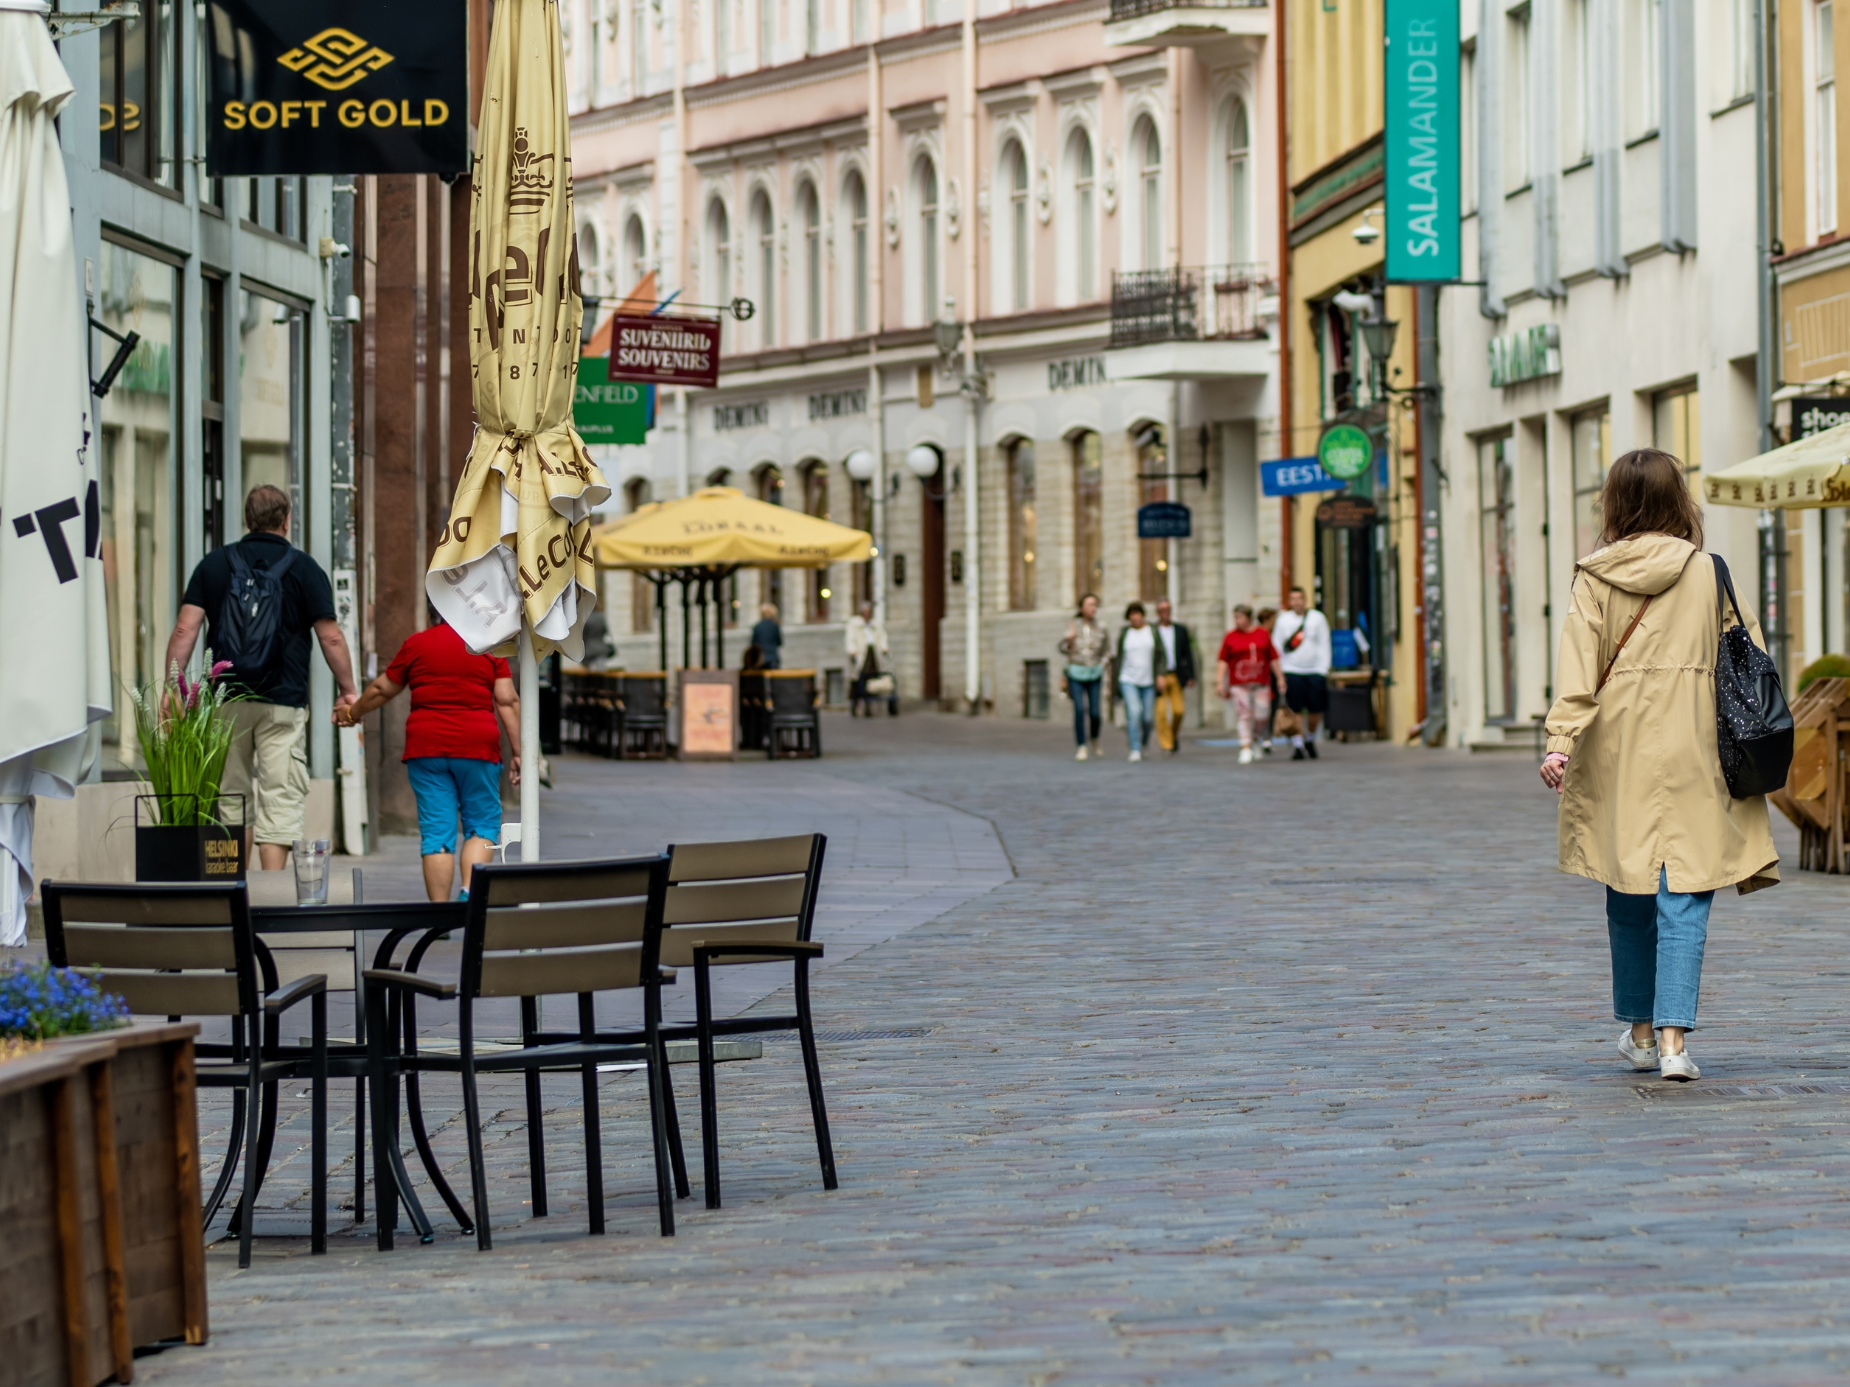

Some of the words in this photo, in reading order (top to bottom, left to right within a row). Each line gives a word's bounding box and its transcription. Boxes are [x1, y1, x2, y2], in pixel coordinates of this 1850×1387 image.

[223, 100, 327, 130] SOFT
[338, 98, 449, 128] GOLD
[1407, 18, 1439, 257] SALAMANDER
[619, 328, 712, 352] SUVENIIRID
[617, 348, 711, 371] SOUVENIRS
[1048, 356, 1107, 391] DEMIN
[573, 384, 638, 404] ENFIELD
[1276, 464, 1331, 487] EEST
[205, 840, 238, 858] HELSINKI
